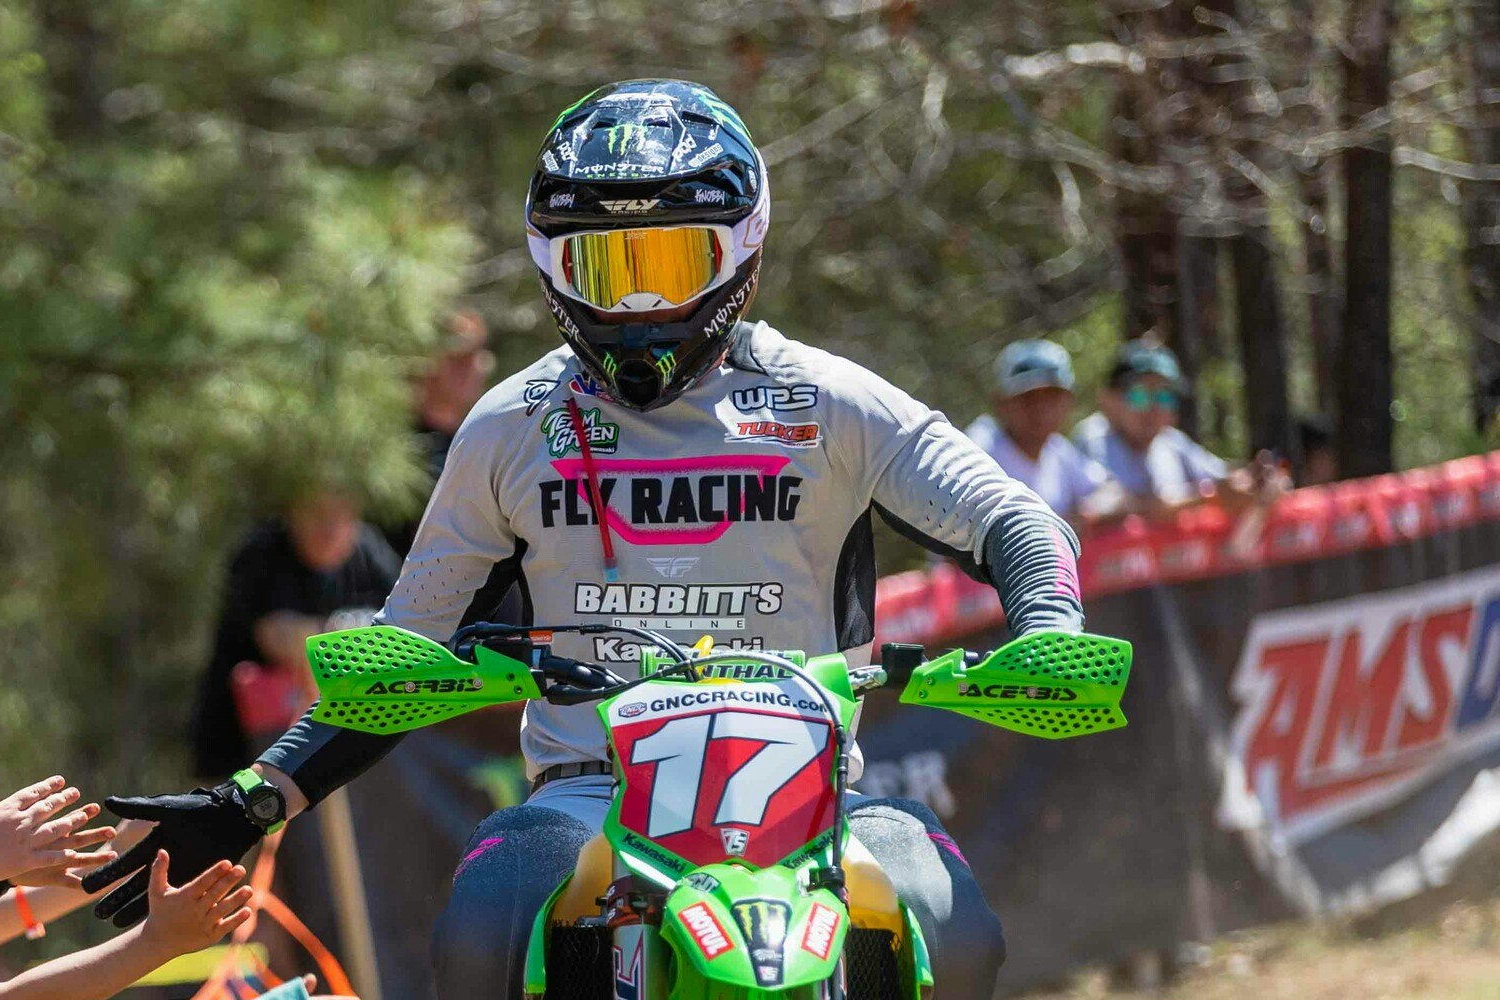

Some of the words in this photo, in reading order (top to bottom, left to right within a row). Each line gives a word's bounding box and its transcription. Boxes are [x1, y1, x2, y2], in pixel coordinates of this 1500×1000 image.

[694, 189, 725, 206] KNOBBY
[732, 384, 819, 412] WPS
[736, 421, 819, 441] TUCKER
[539, 477, 617, 528] FLY
[631, 474, 803, 525] RACING
[574, 582, 784, 616] BABBITT'S
[628, 711, 832, 839] 17
[622, 833, 687, 873] Kawasaki
[682, 904, 729, 956] MOTUL
